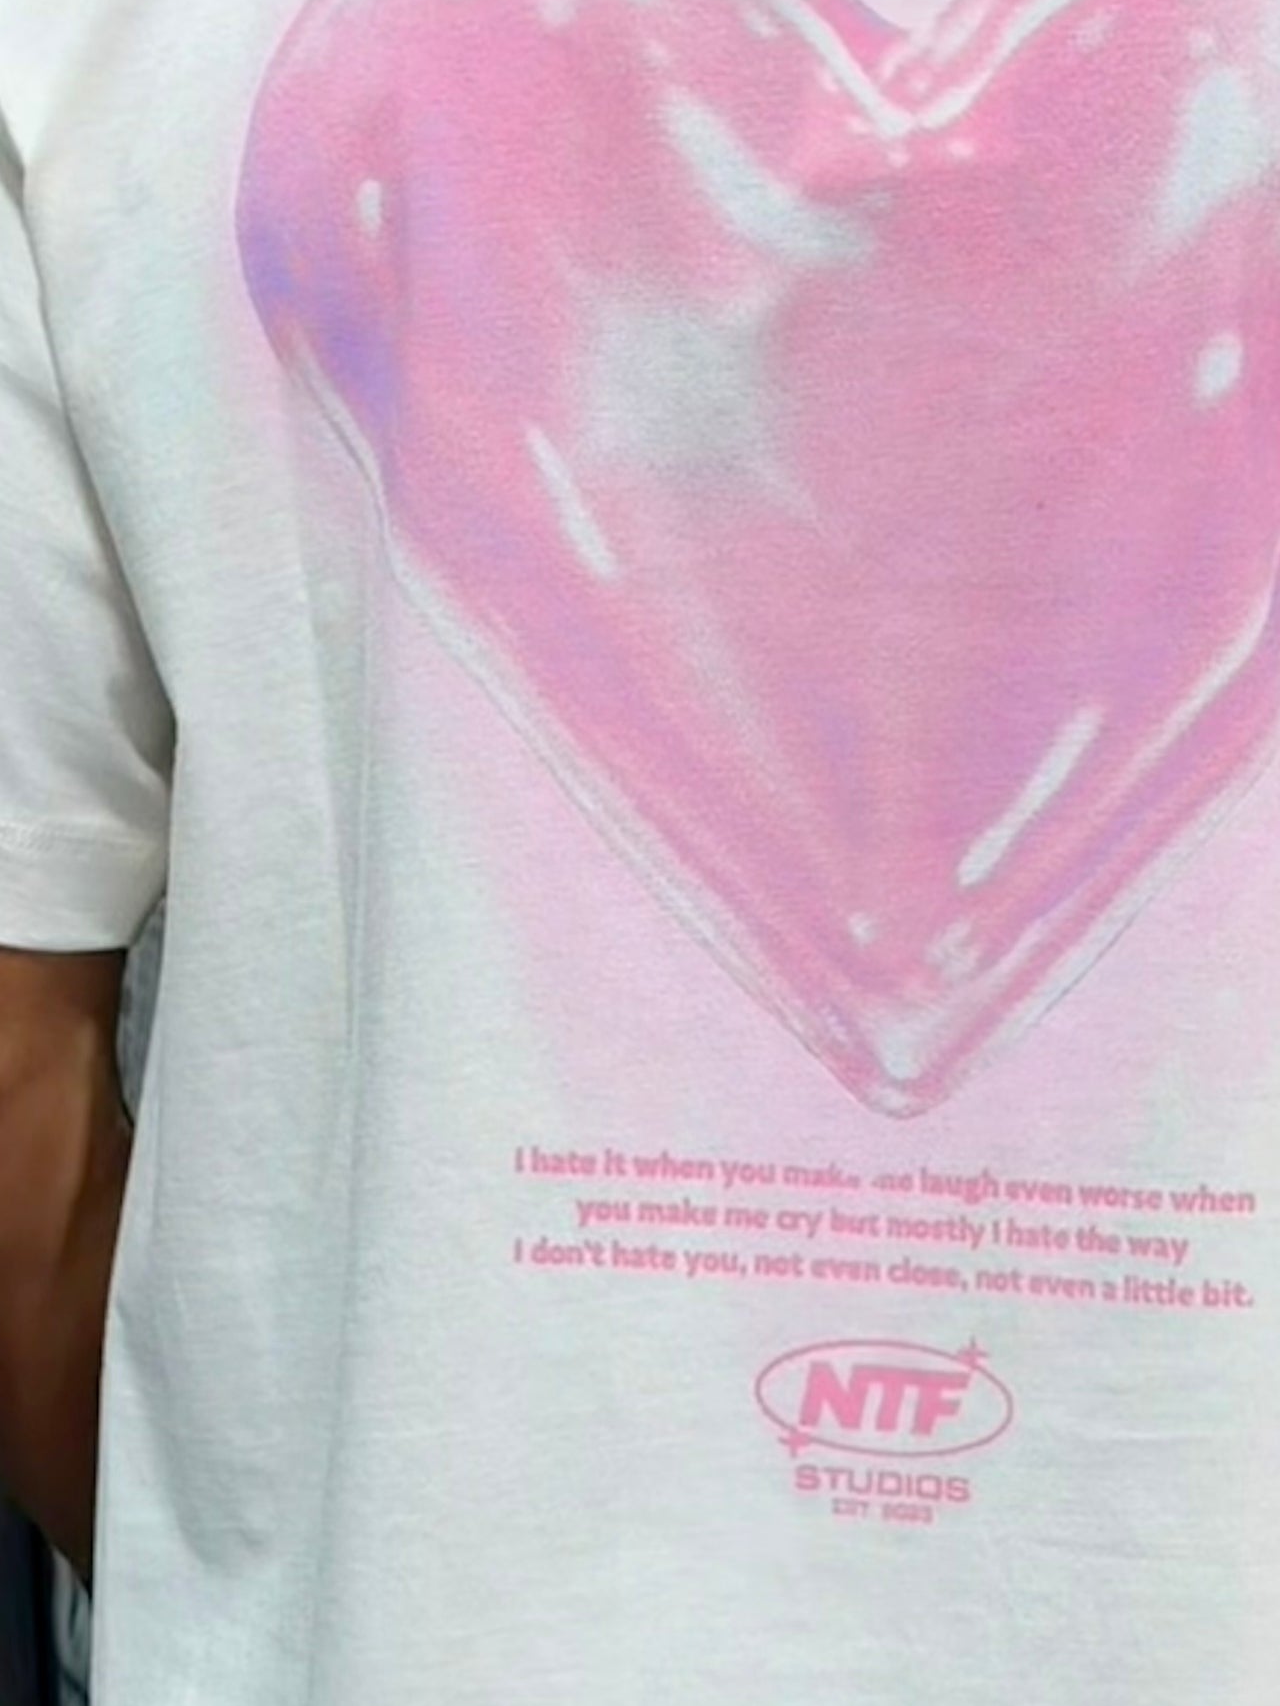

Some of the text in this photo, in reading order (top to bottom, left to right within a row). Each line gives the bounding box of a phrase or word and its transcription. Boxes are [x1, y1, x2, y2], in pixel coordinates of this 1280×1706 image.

[515, 1148, 524, 1173] I
[532, 1148, 597, 1177] hate
[604, 1149, 628, 1177] it
[632, 1152, 715, 1180] when
[720, 1159, 776, 1189] you
[782, 1162, 862, 1190] make
[919, 1168, 1000, 1206] laugh
[1004, 1181, 1073, 1205] even
[1079, 1186, 1164, 1212] worse
[1168, 1183, 1257, 1213] when
[575, 1197, 1190, 1265] you make me cry but mostly I hate the way
[514, 1236, 1256, 1309] I don't hate you, not even close, not even a little bit.
[798, 1360, 971, 1437] NTF
[794, 1463, 972, 1503] STUDIOS
